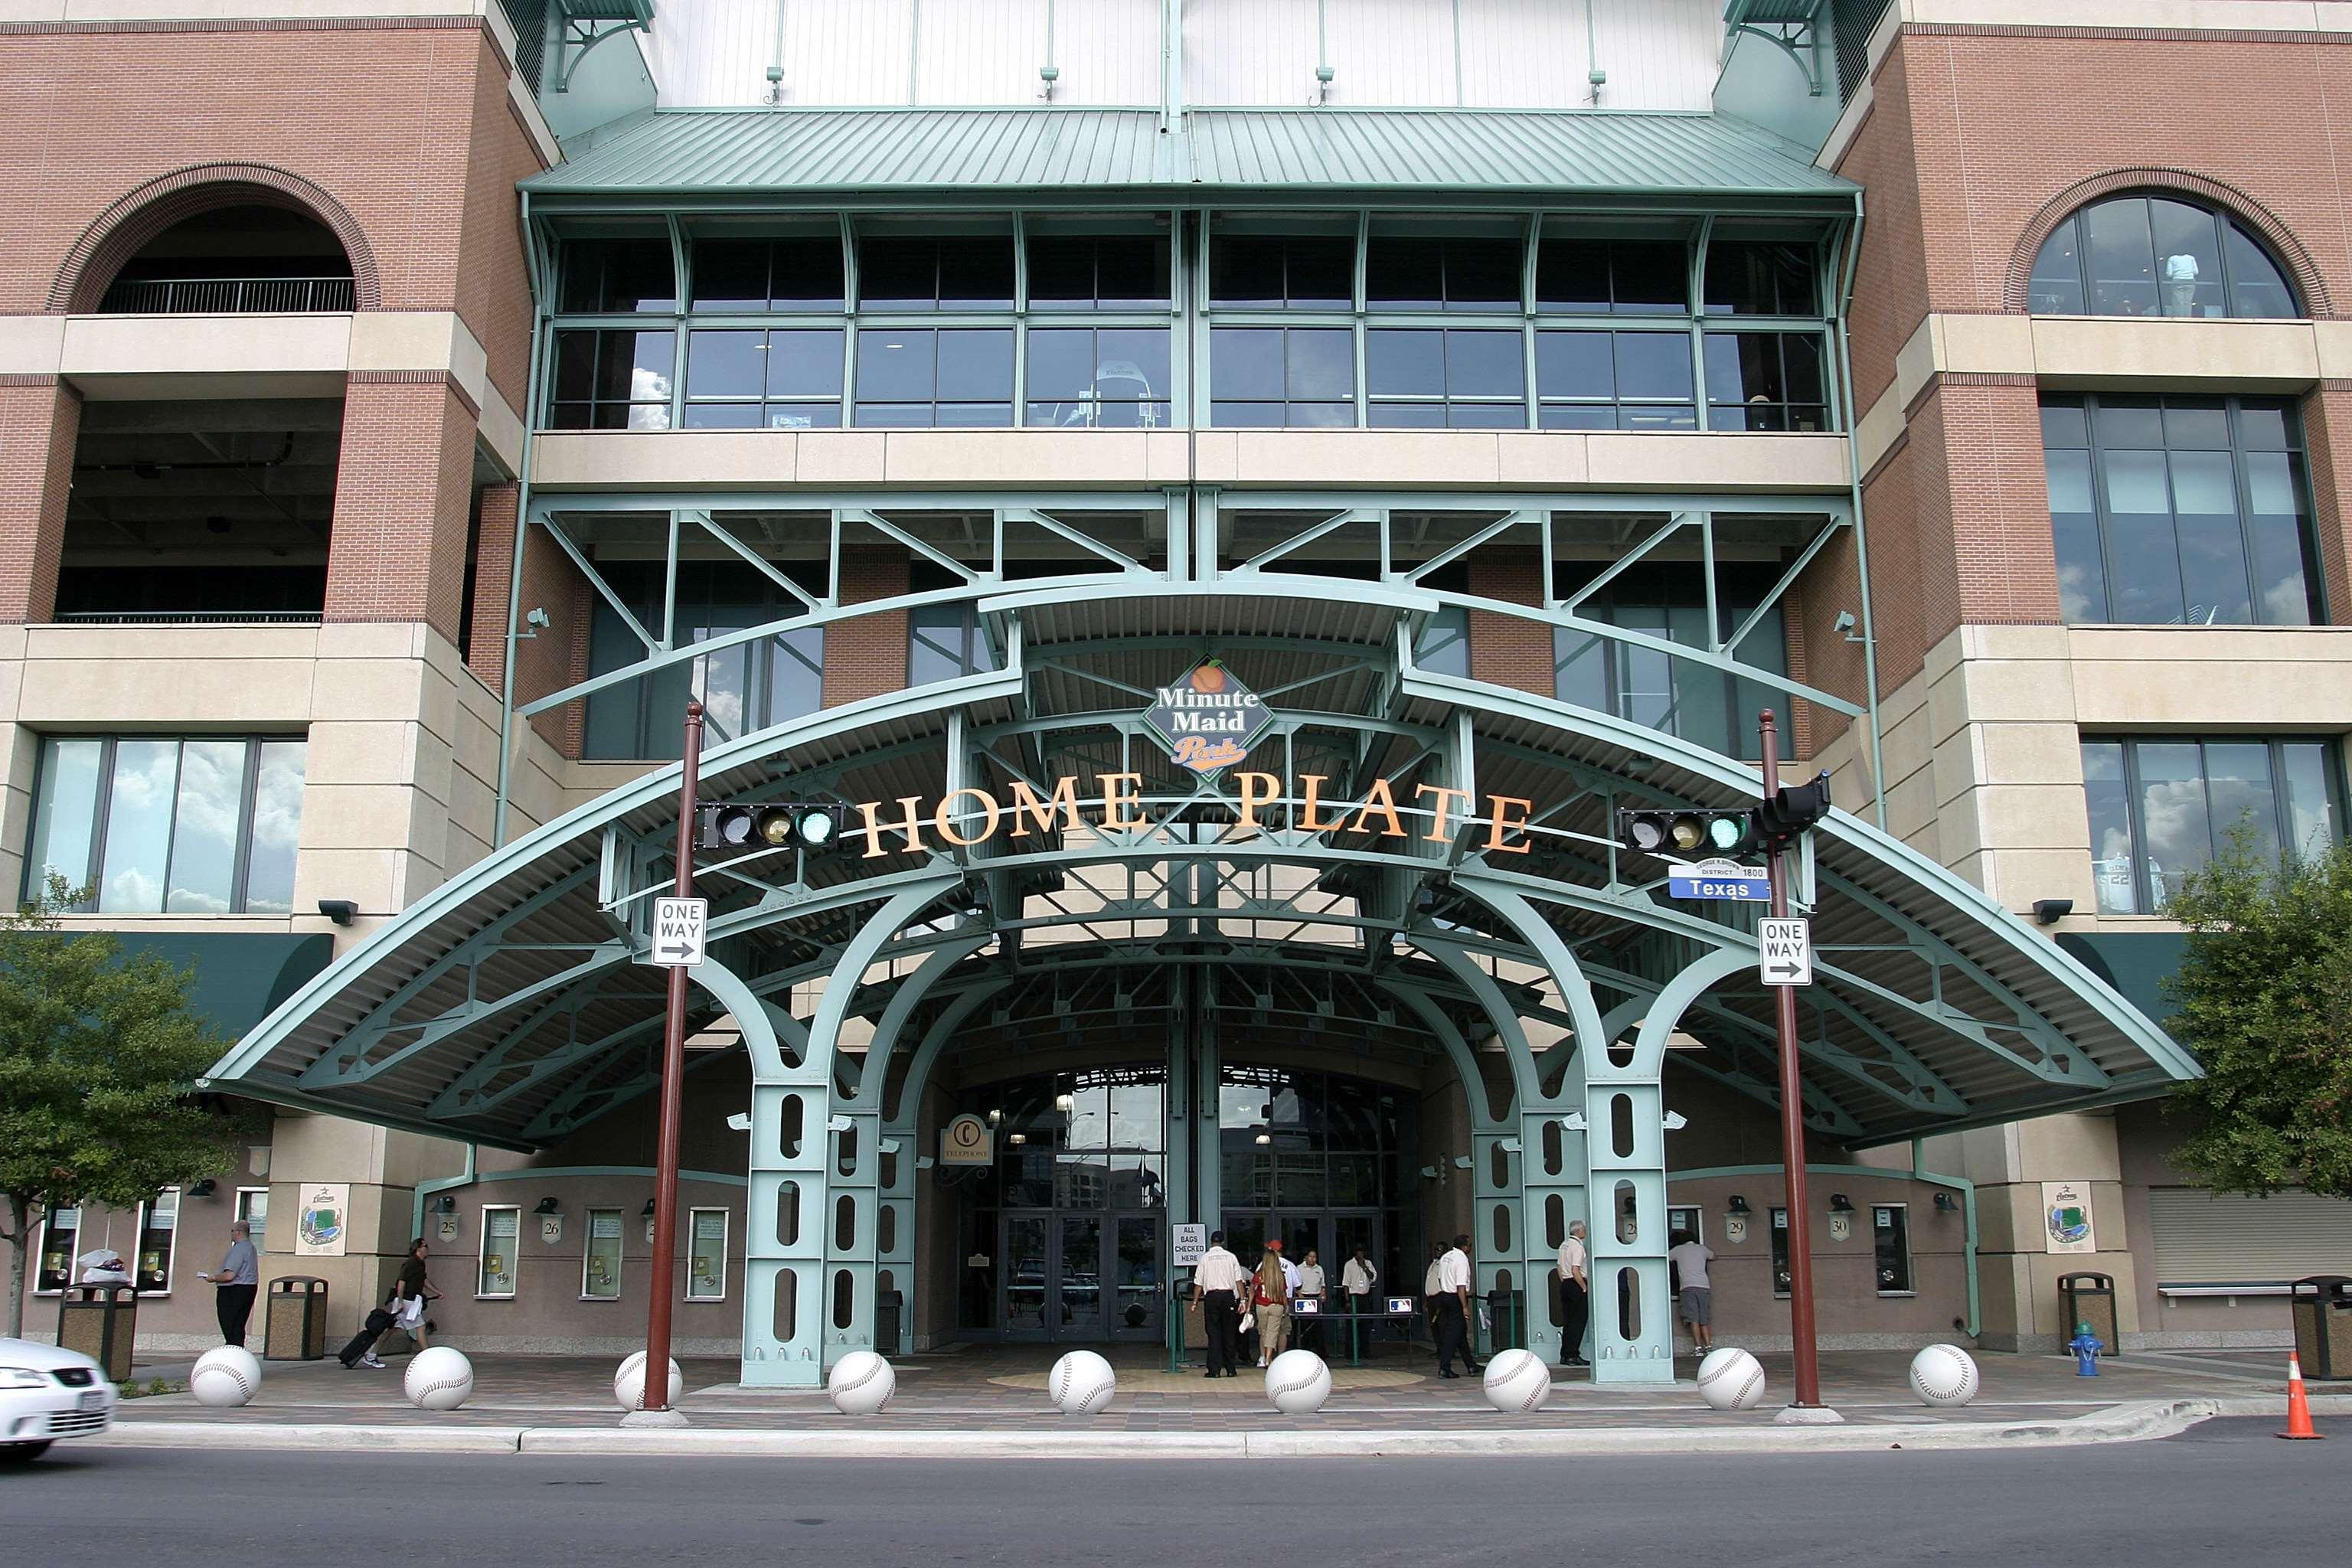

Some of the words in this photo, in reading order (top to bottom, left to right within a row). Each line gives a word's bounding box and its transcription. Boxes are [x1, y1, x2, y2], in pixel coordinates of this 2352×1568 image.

[1156, 688, 1260, 708] Minute
[1171, 710, 1245, 732] Maid
[1171, 736, 1247, 771] Park
[855, 772, 1147, 859] HOME
[1233, 772, 1533, 854] PLATE
[2111, 875, 2129, 885] 22
[1690, 880, 1749, 897] Texas
[662, 904, 700, 920] ONE
[662, 923, 700, 938] WAY
[1766, 924, 1802, 939] ONE
[1766, 942, 1803, 957] WAY
[441, 1222, 455, 1233] 25
[544, 1223, 559, 1234] 26
[1729, 1222, 1743, 1233] 29
[1832, 1220, 1847, 1233] 30
